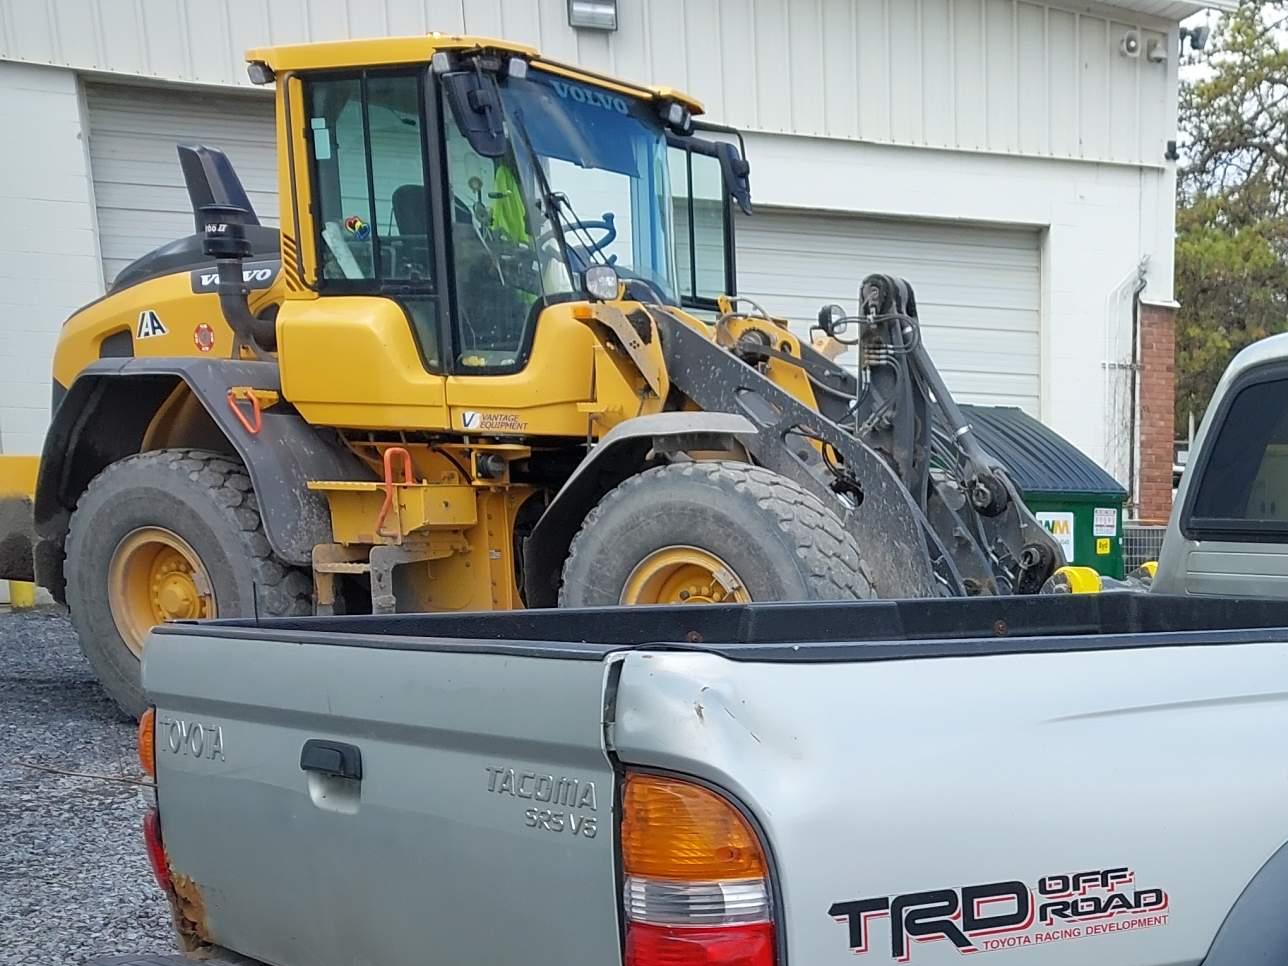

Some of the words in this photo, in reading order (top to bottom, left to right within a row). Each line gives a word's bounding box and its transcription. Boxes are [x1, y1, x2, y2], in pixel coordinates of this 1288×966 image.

[549, 80, 629, 114] VOLVO
[479, 420, 529, 431] EQUIPMENT
[480, 413, 521, 423] VANTAGE
[158, 717, 226, 763] TOYOTA
[485, 766, 598, 812] TACOMA
[568, 813, 598, 839] V6
[1038, 867, 1134, 899] OFF
[828, 881, 1033, 962] TRD
[1038, 887, 1169, 926] ROAD
[983, 935, 1031, 951] TOYOTA
[1035, 927, 1081, 944] RACING
[1085, 914, 1169, 936] DEVELOPMENT
